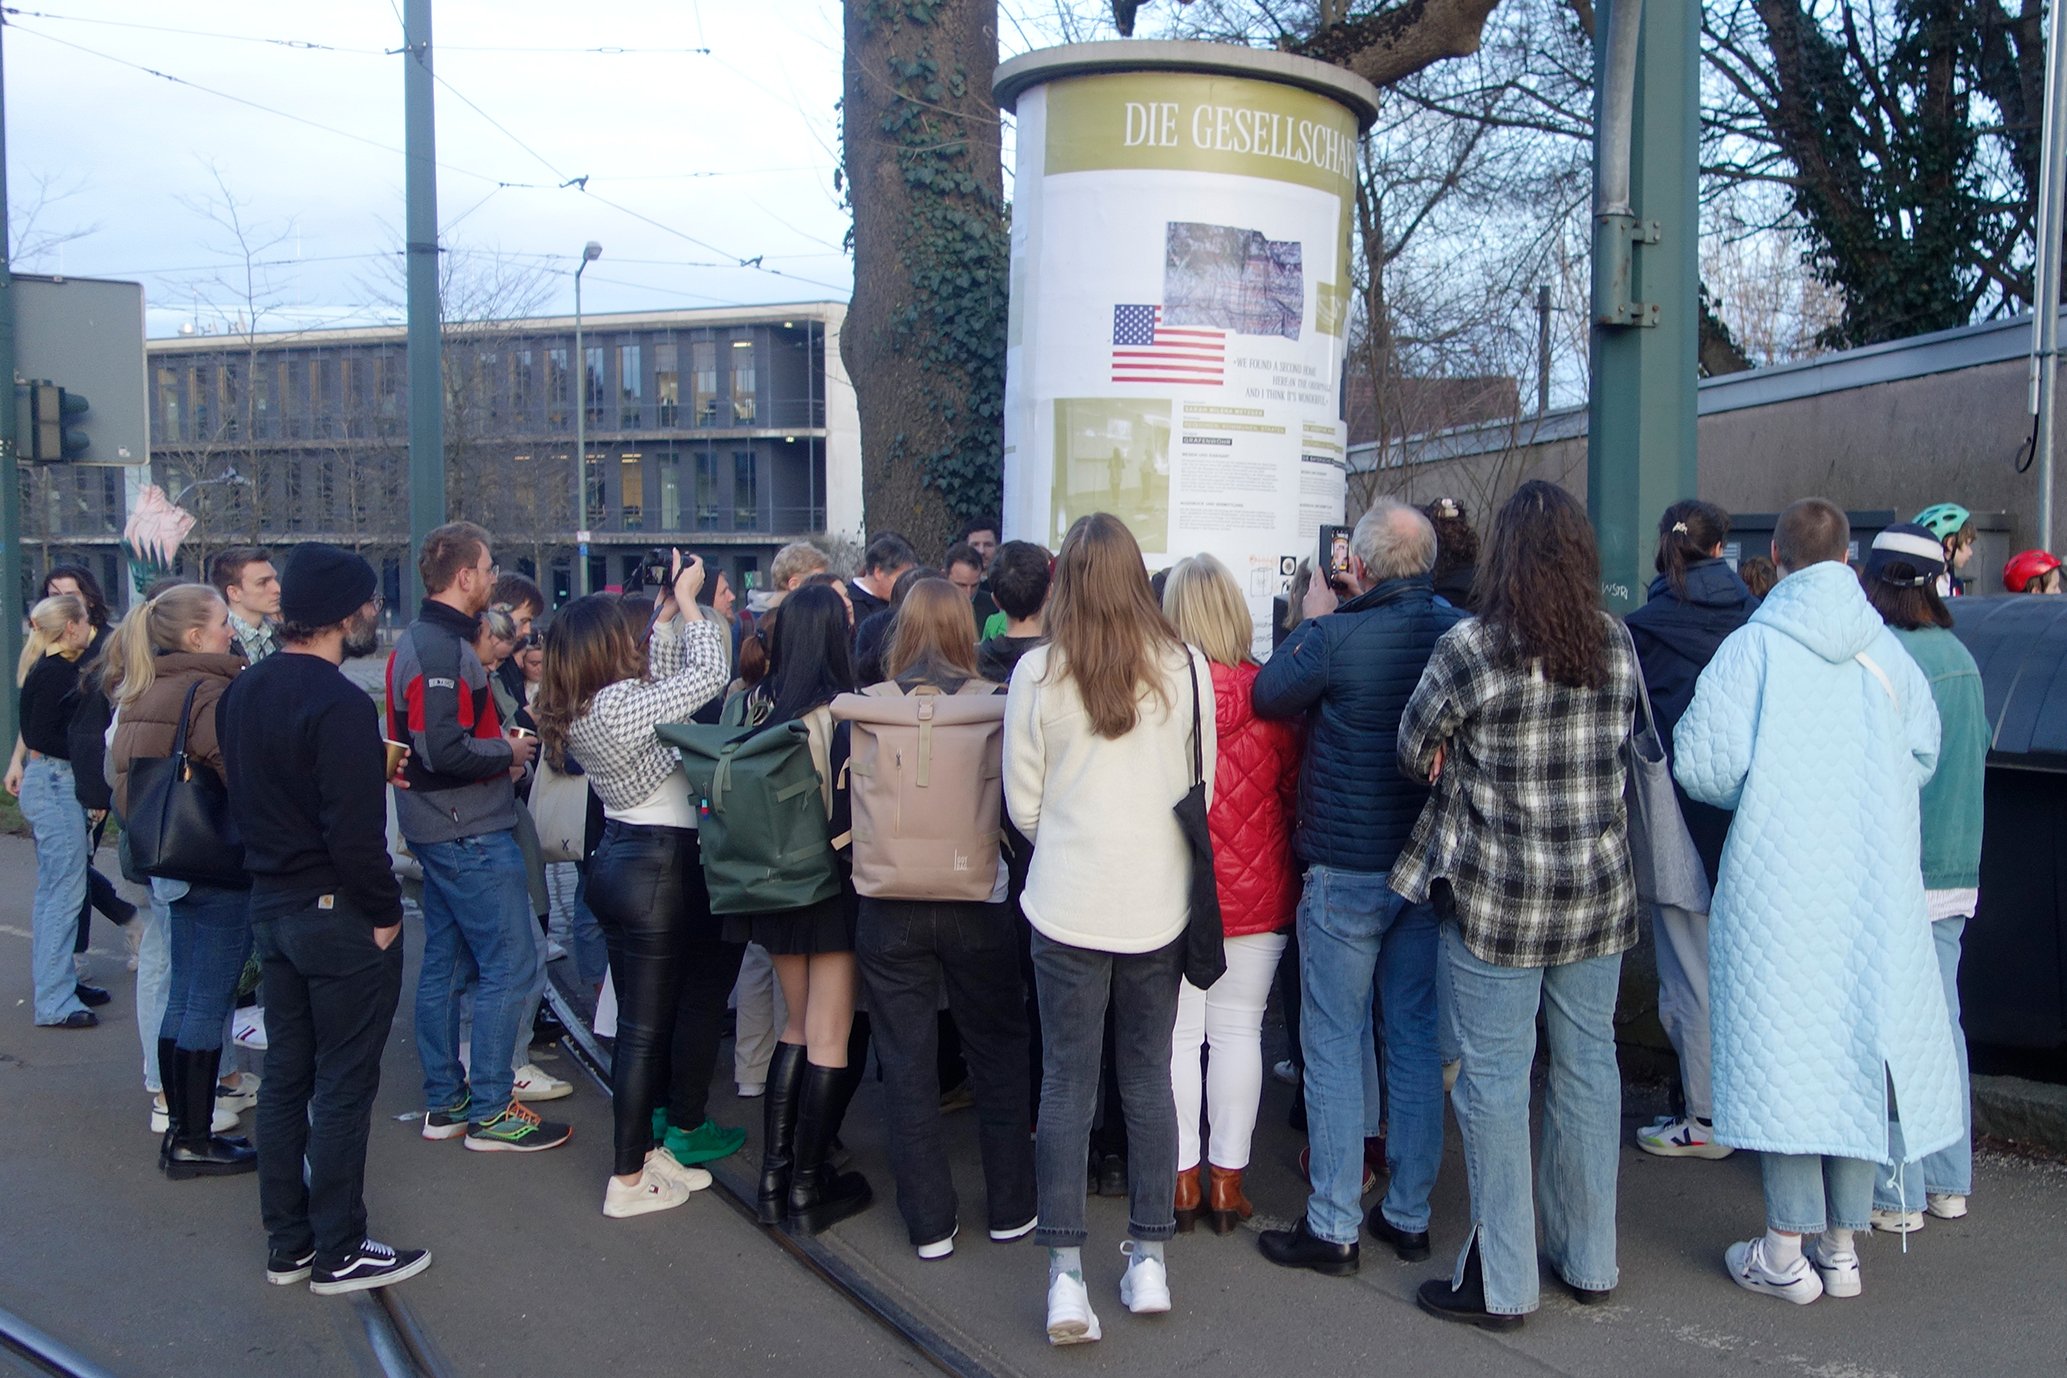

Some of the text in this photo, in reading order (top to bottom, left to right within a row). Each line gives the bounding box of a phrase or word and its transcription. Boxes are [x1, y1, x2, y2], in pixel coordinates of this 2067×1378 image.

[1124, 102, 1357, 185] DIE GESELLSCHAF
[1249, 359, 1272, 370] FOUND
[1273, 360, 1278, 372] A
[1246, 387, 1260, 398] AND
[1266, 388, 1286, 401] THINK
